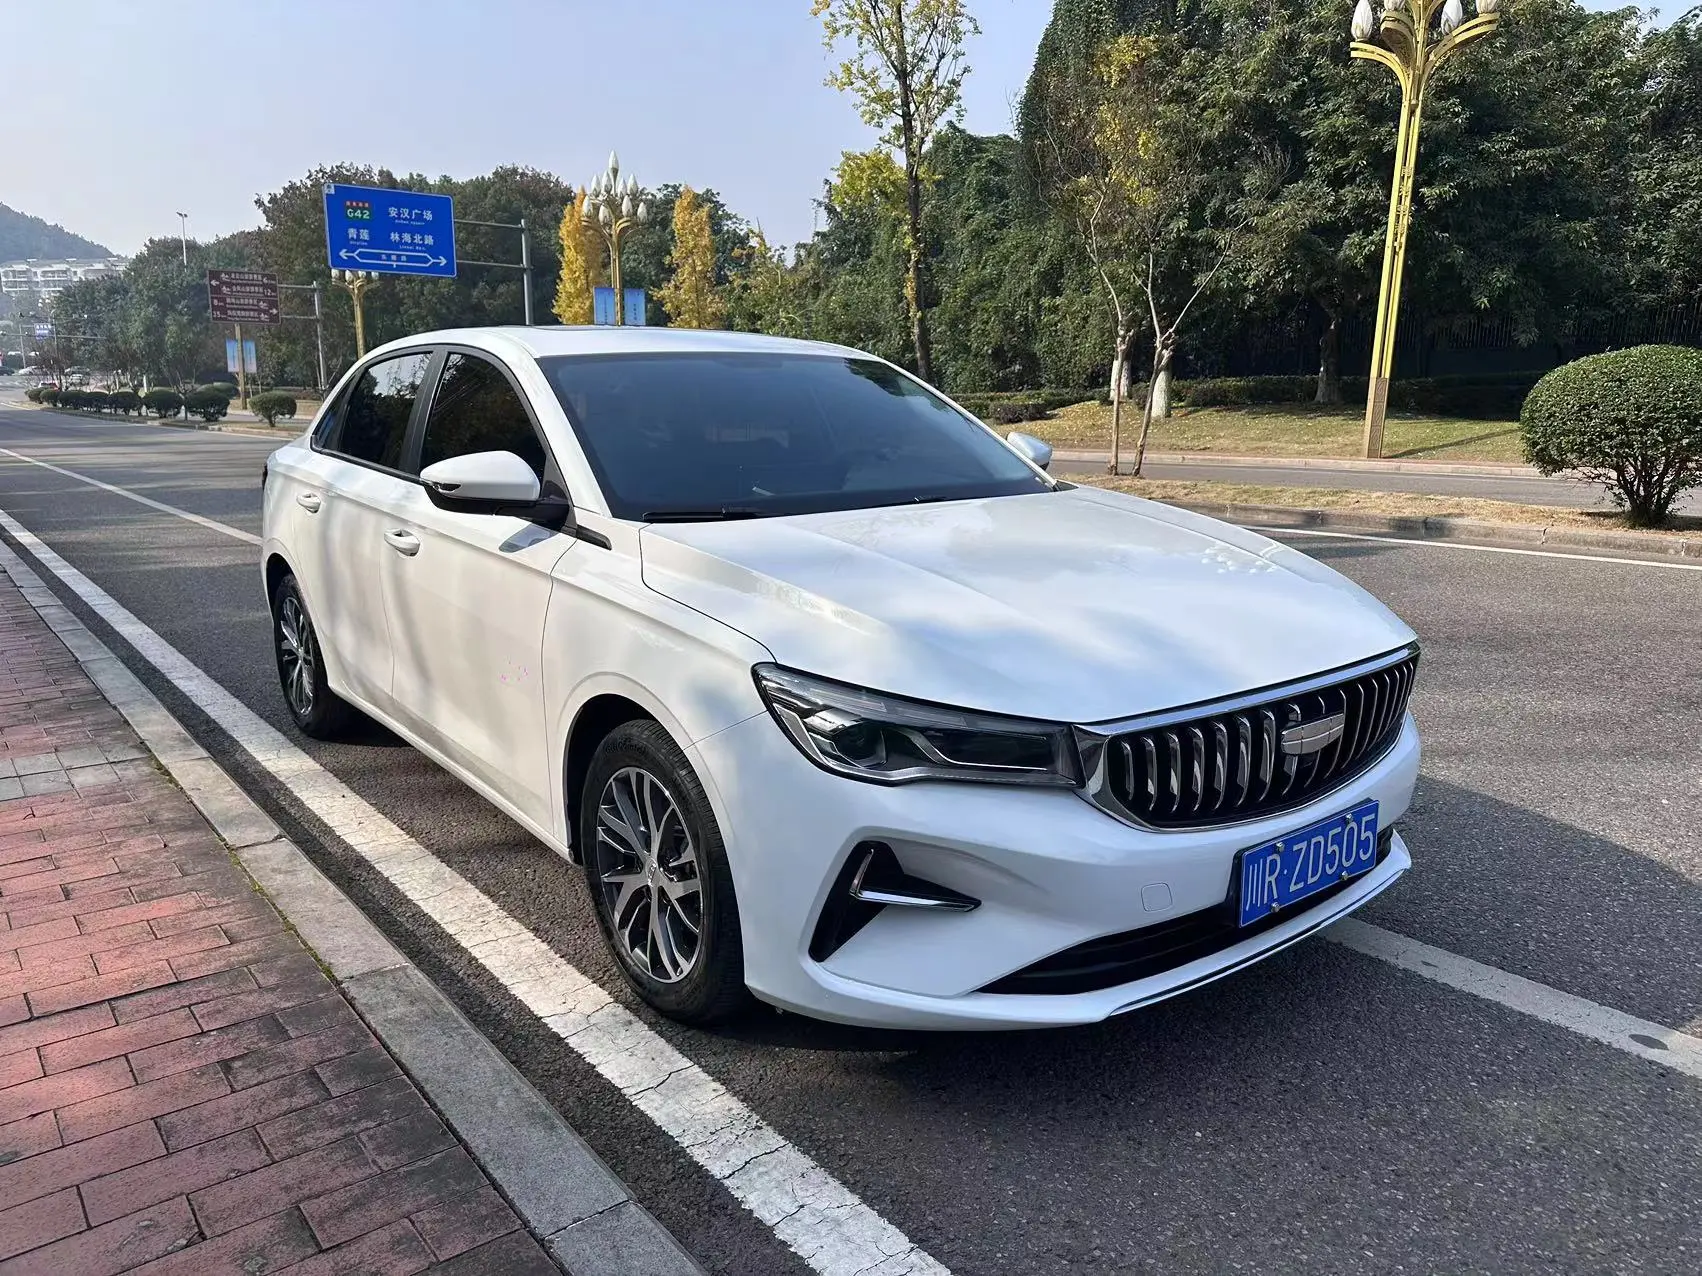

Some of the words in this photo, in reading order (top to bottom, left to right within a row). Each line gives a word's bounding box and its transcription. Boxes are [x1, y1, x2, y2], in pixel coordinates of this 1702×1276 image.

[347, 208, 370, 220] G42
[388, 206, 433, 221] 安汉广场
[347, 227, 370, 241] 青莲
[390, 231, 434, 246] 林海北路
